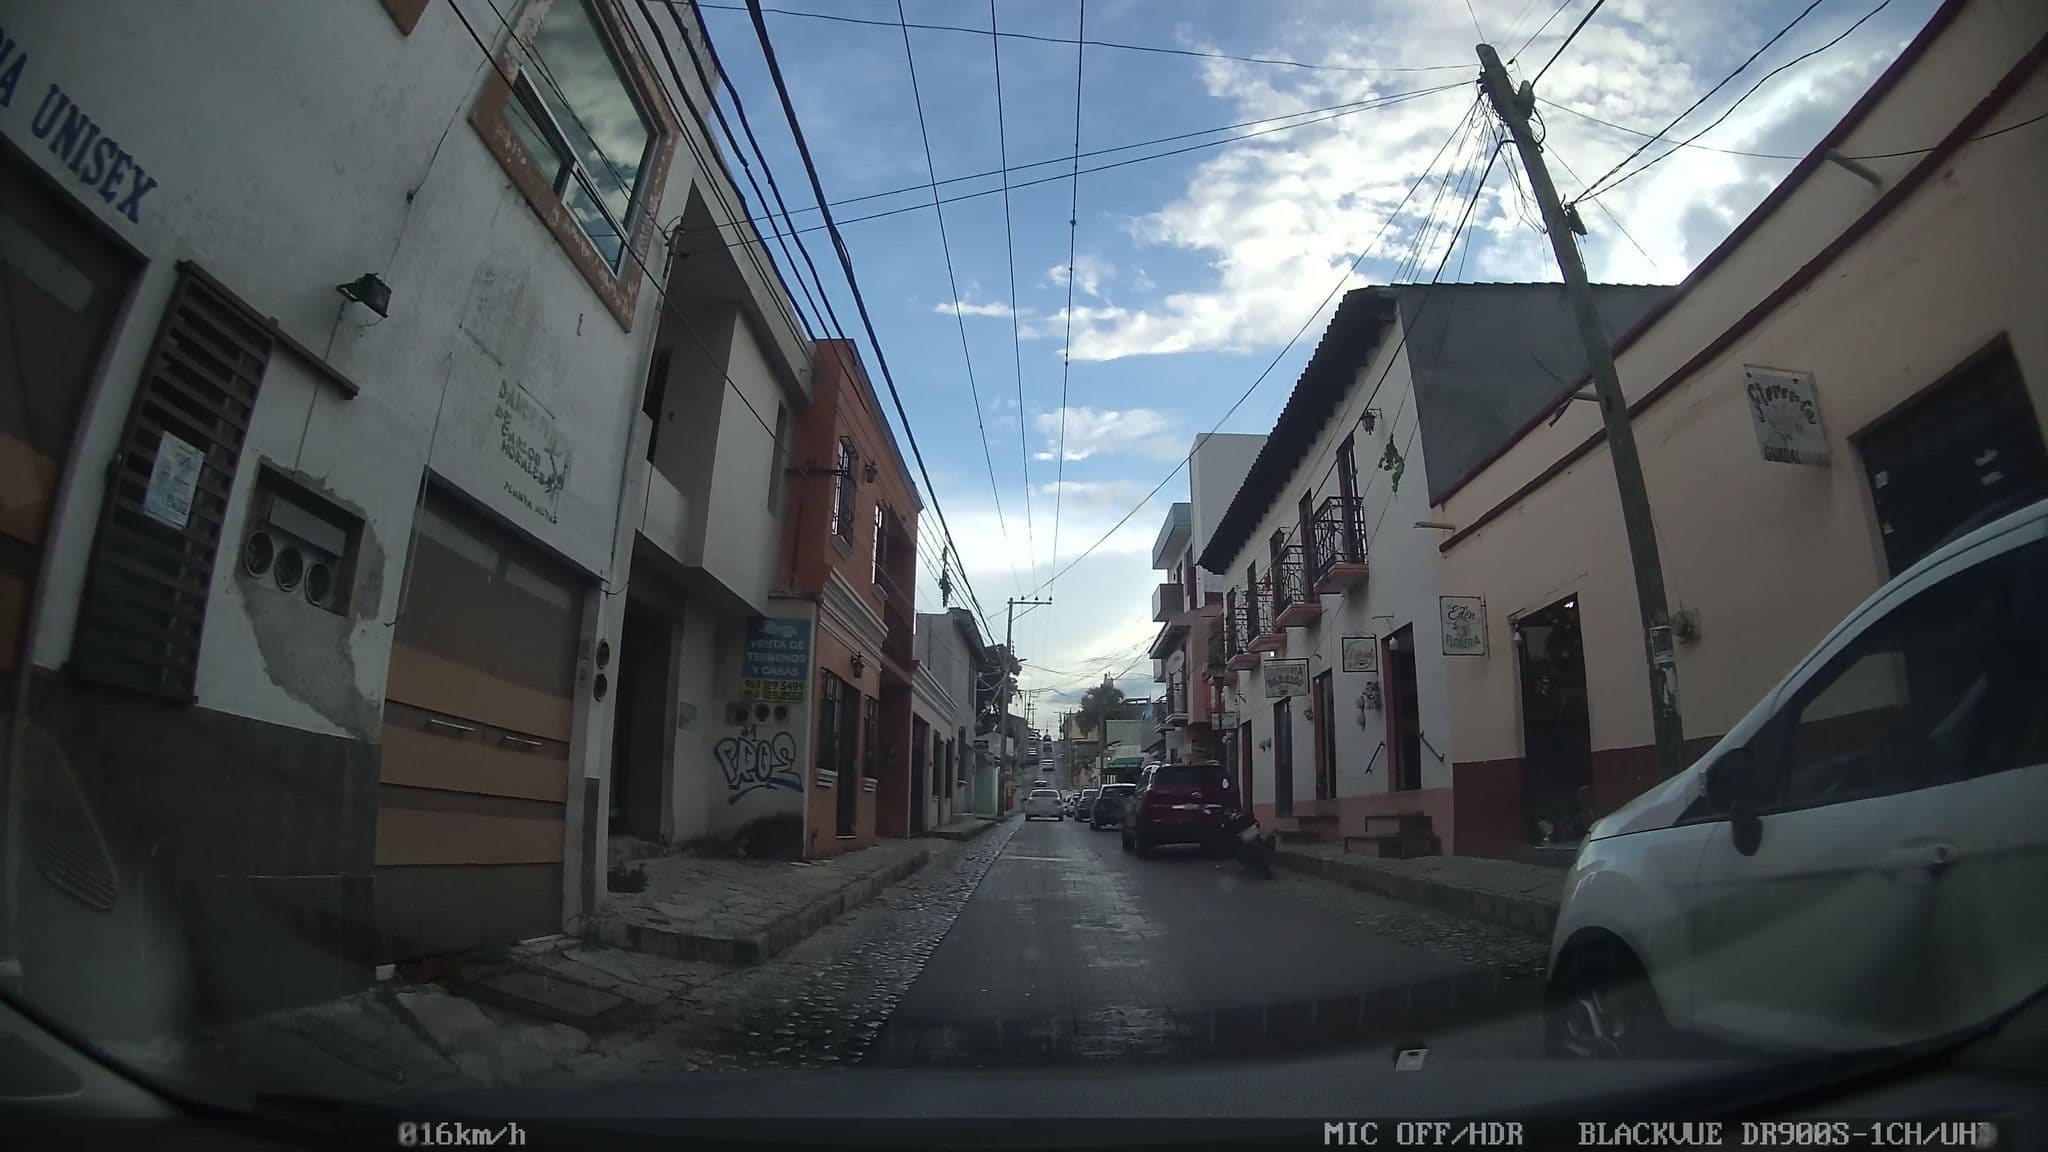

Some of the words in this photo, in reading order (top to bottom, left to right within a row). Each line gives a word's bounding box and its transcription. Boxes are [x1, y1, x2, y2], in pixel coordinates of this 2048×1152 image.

[32, 84, 157, 224] UNISEX
[750, 639, 786, 649] VENTA
[789, 640, 806, 650] DE
[746, 651, 807, 663] TERRENOS
[752, 665, 760, 674] Y
[761, 666, 800, 677] CASAS
